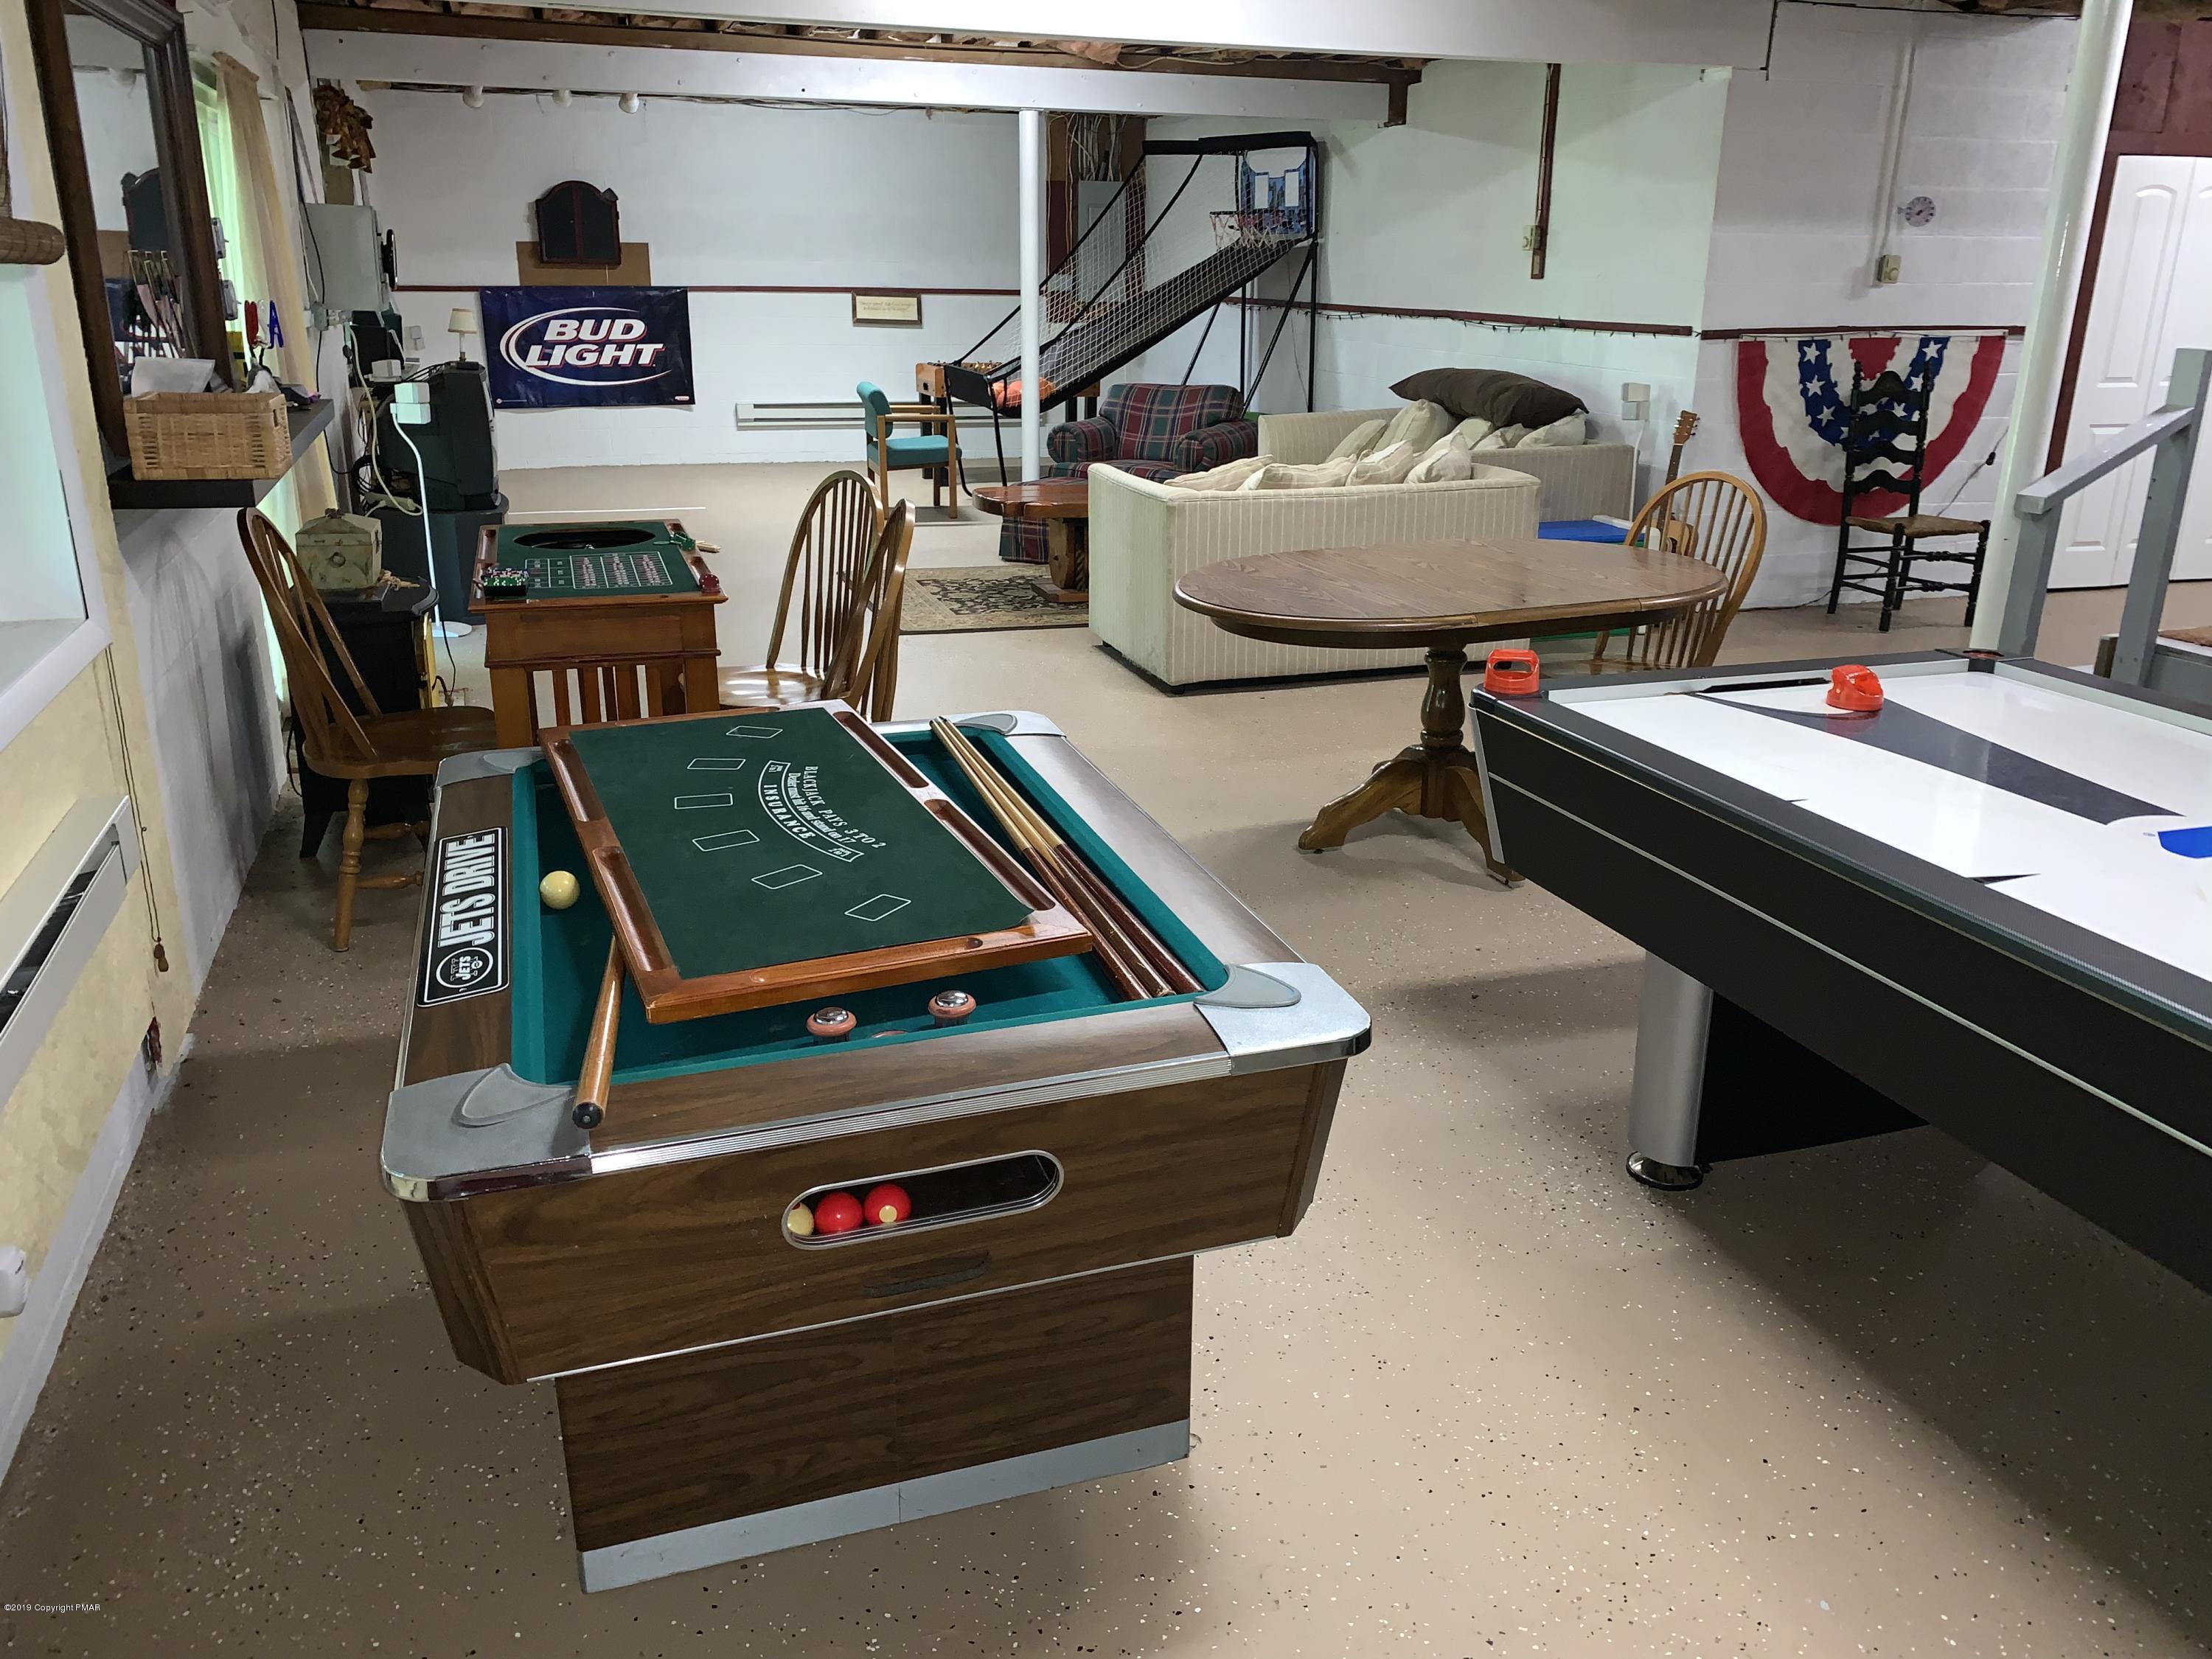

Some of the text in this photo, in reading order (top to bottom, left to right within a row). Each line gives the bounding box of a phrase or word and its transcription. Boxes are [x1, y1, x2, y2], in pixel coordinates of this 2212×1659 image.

[525, 343, 665, 368] LIGHT
[543, 319, 647, 342] BUD
[764, 785, 816, 839] INSURANCE
[787, 773, 801, 787] Dealer
[801, 810, 821, 821] and
[811, 820, 836, 832] stand
[828, 831, 843, 839] on
[801, 766, 826, 806] BLACKJACK
[818, 809, 848, 827] PAYS
[852, 832, 876, 844] TO
[437, 833, 495, 948] JETS DRIVE
[455, 956, 472, 981] JETS
